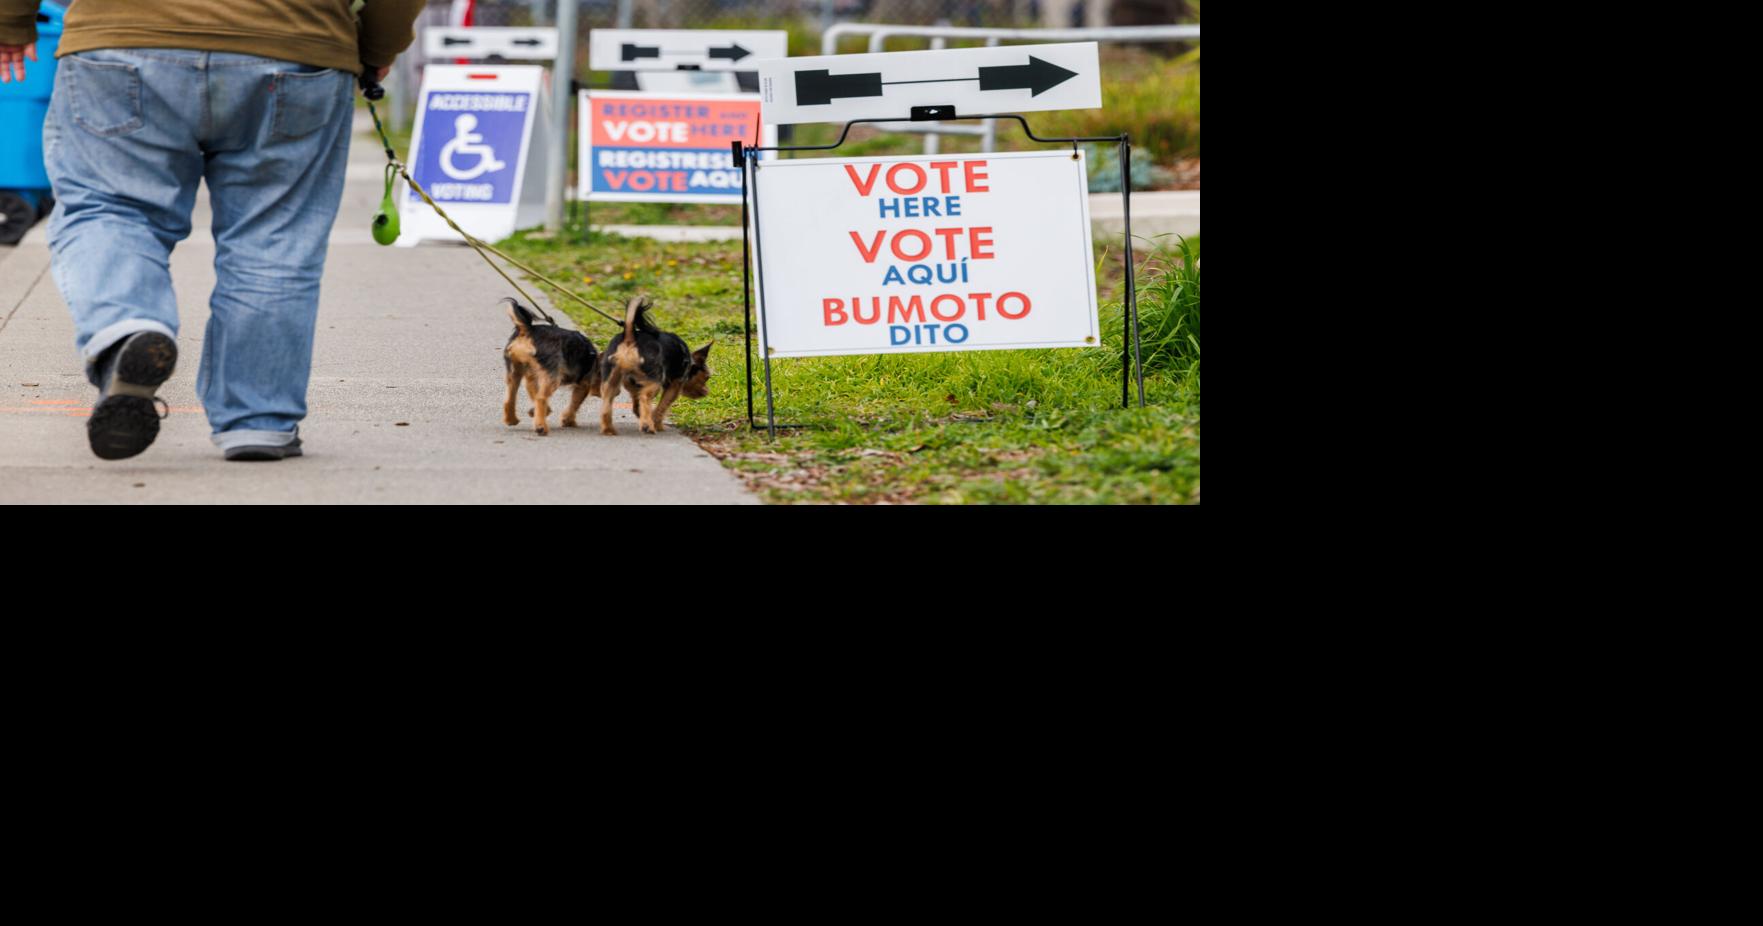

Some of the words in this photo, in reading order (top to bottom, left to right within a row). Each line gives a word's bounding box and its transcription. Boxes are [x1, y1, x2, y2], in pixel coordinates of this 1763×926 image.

[602, 103, 710, 118] REGISTER
[602, 120, 690, 143] VOTE
[691, 124, 748, 136] HERE
[602, 170, 689, 191] VOTE
[689, 171, 743, 189] AQU
[844, 160, 989, 197] VOTE
[879, 196, 961, 218] HERE
[849, 227, 995, 263] VOTE
[882, 257, 968, 286] AQUÍ
[822, 291, 1032, 326] BUMOTO
[890, 323, 969, 346] DITO
